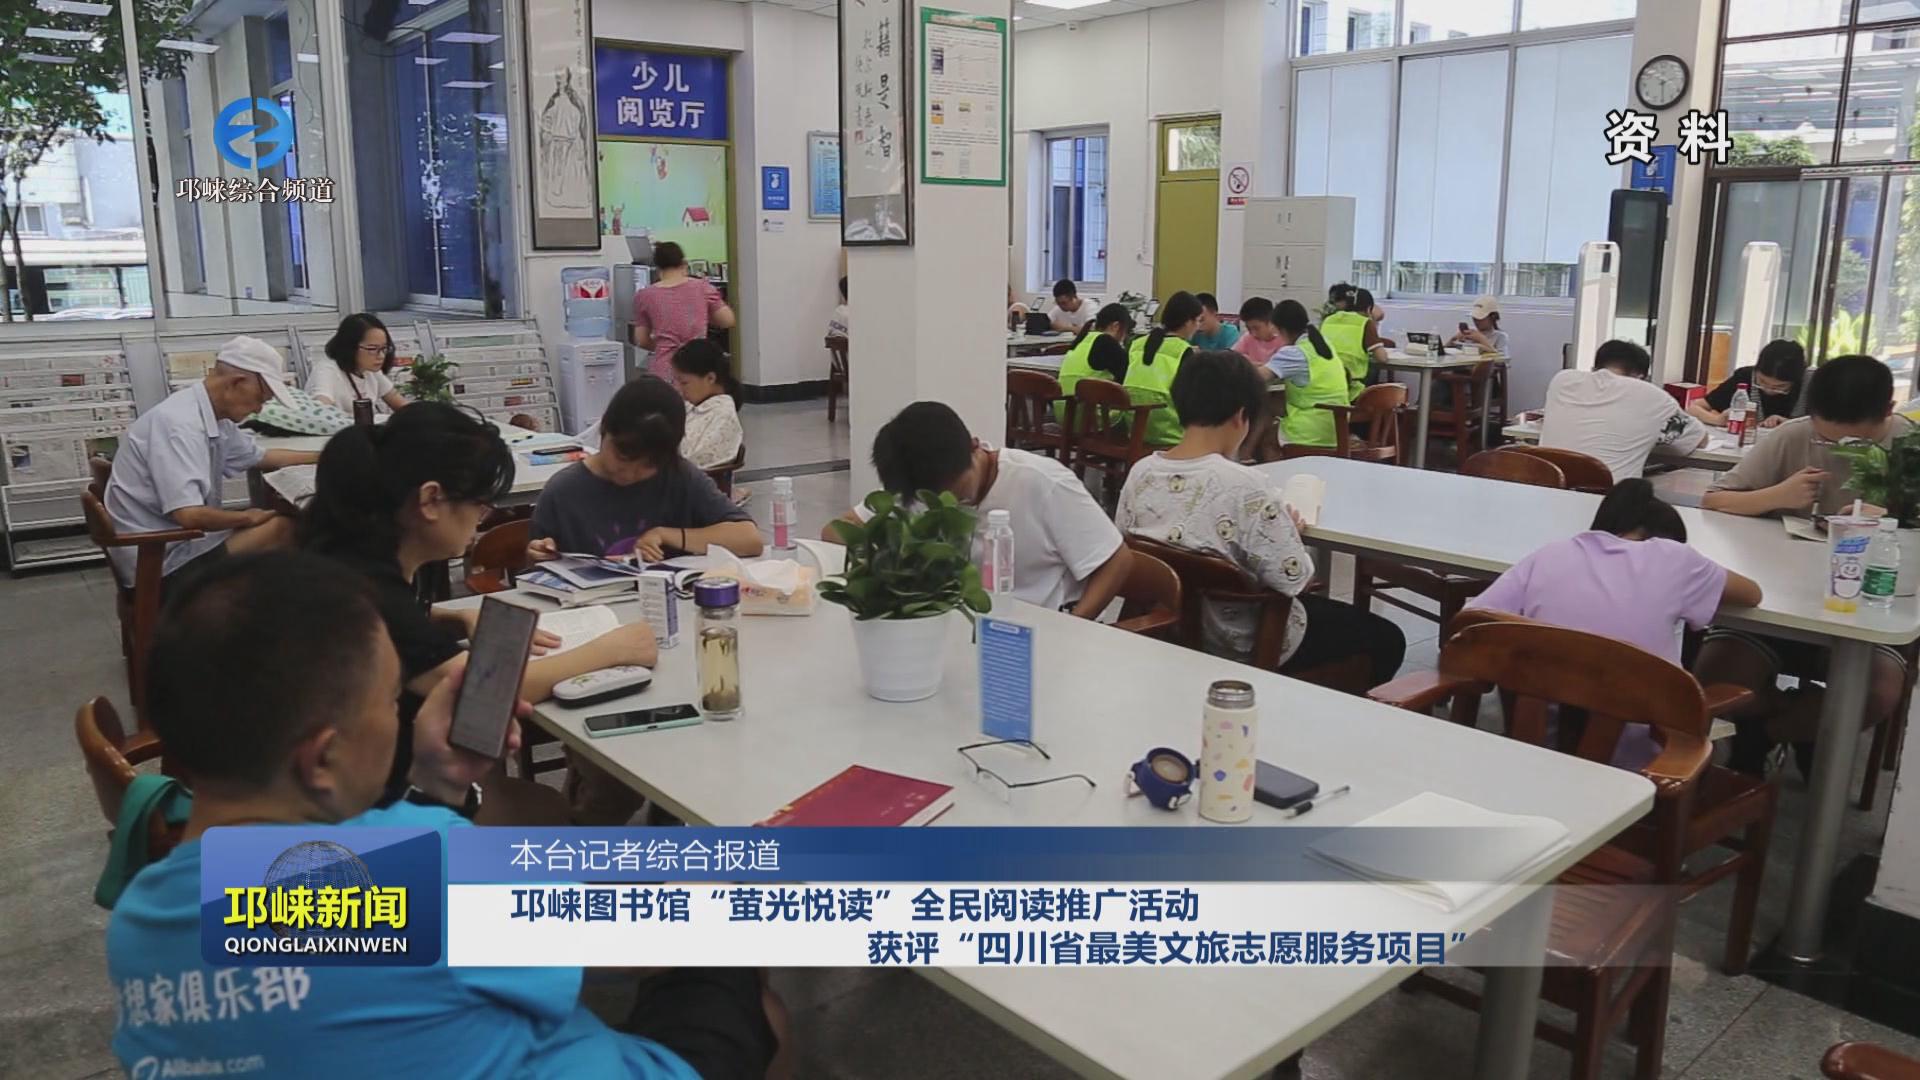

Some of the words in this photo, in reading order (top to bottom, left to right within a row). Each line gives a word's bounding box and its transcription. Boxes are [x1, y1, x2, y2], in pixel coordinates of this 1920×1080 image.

[632, 60, 690, 93] 少儿
[616, 96, 705, 130] 阅览厅
[117, 967, 311, 1027] 想家俱乐部
